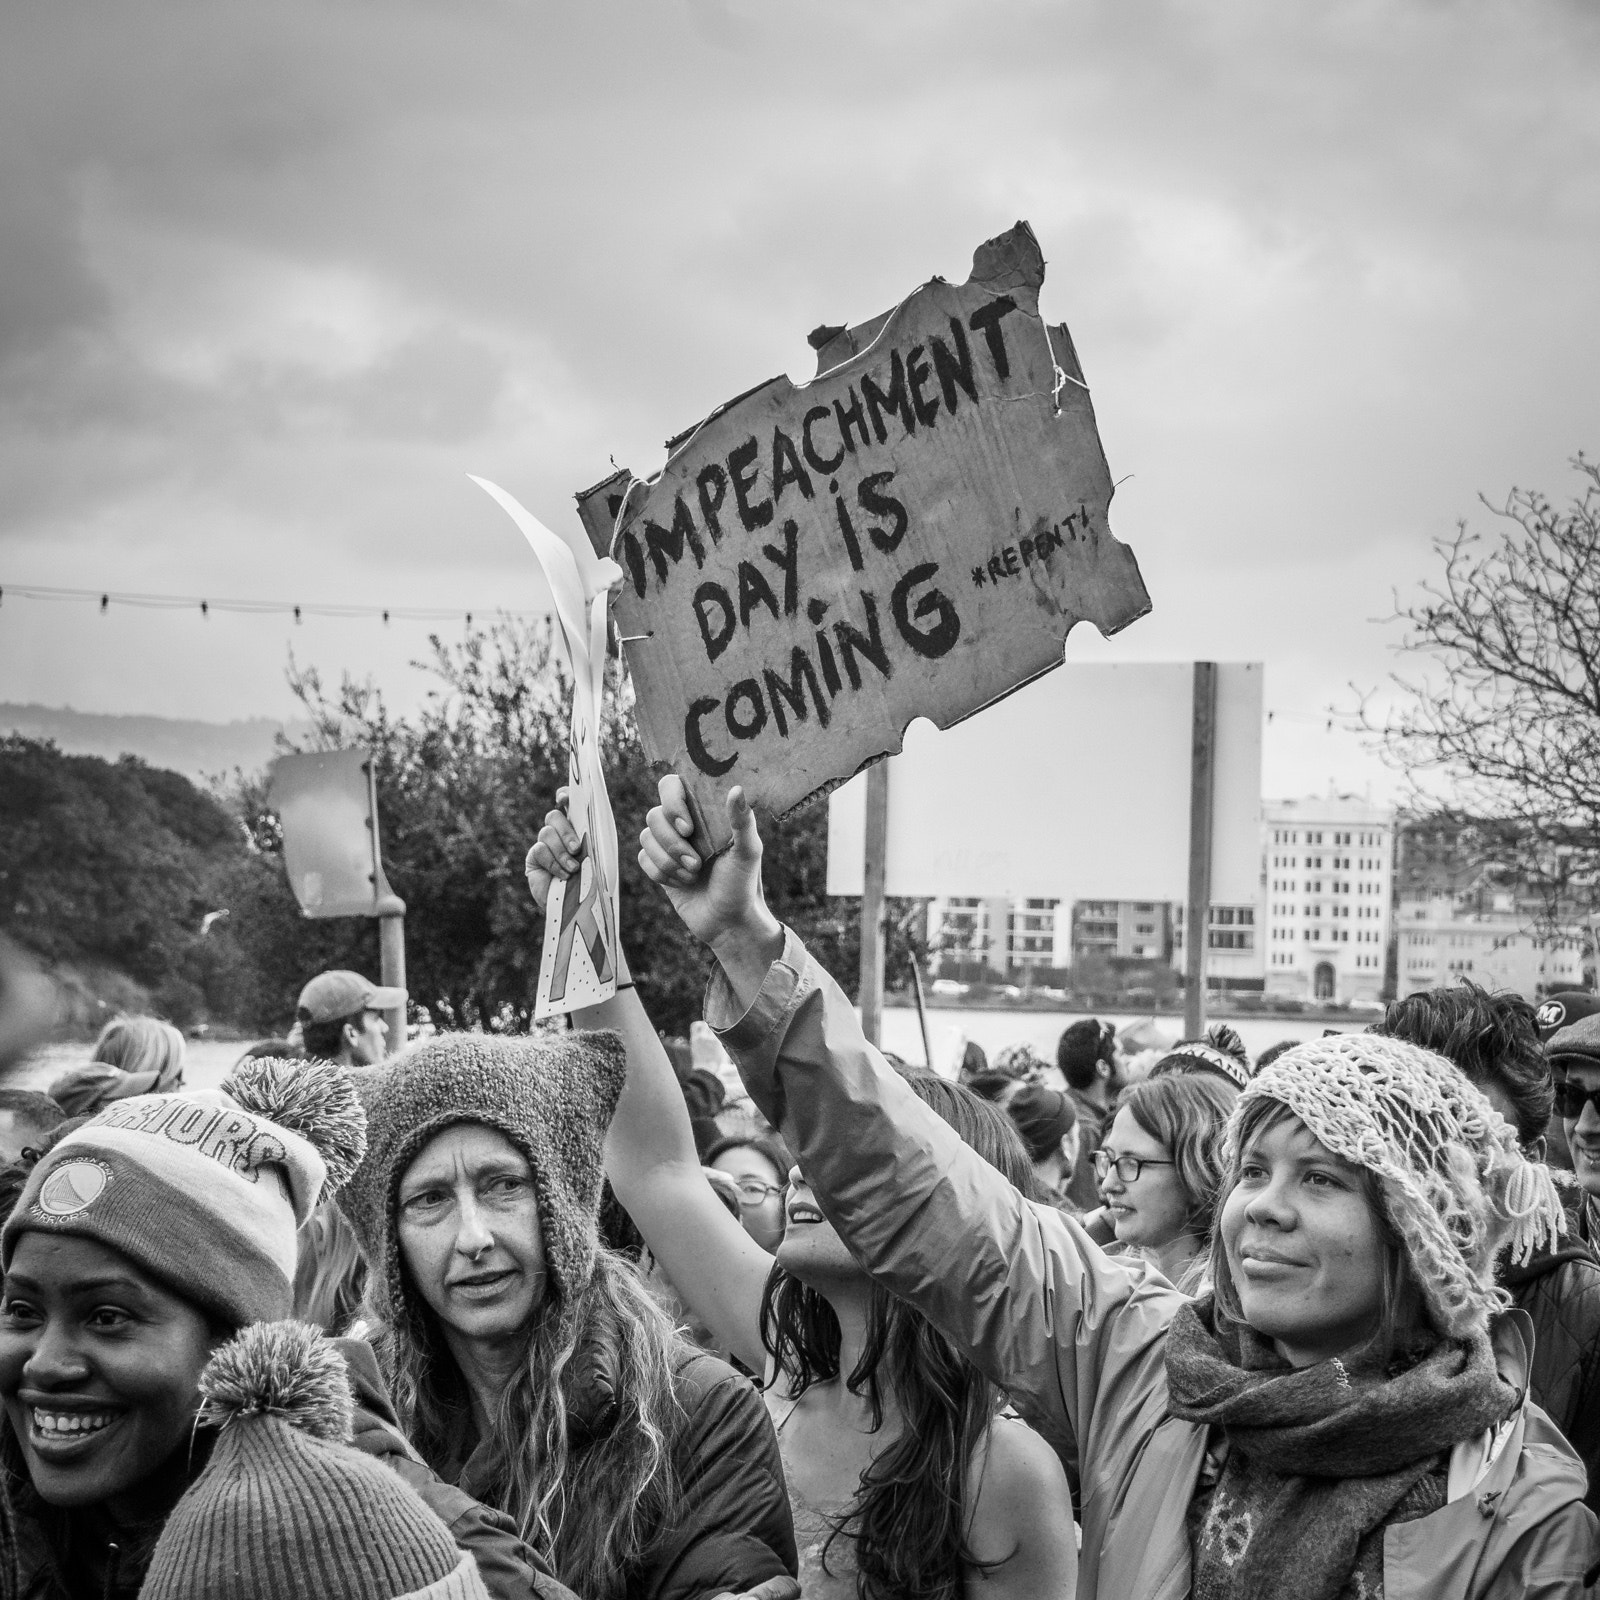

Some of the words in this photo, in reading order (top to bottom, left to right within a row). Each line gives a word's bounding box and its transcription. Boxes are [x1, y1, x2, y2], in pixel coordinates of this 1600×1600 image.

[610, 295, 1017, 600] IMPEACHMENT
[693, 520, 798, 663] DAY
[1536, 1004, 1562, 1023] M
[29, 1203, 90, 1225] WARRIORS
